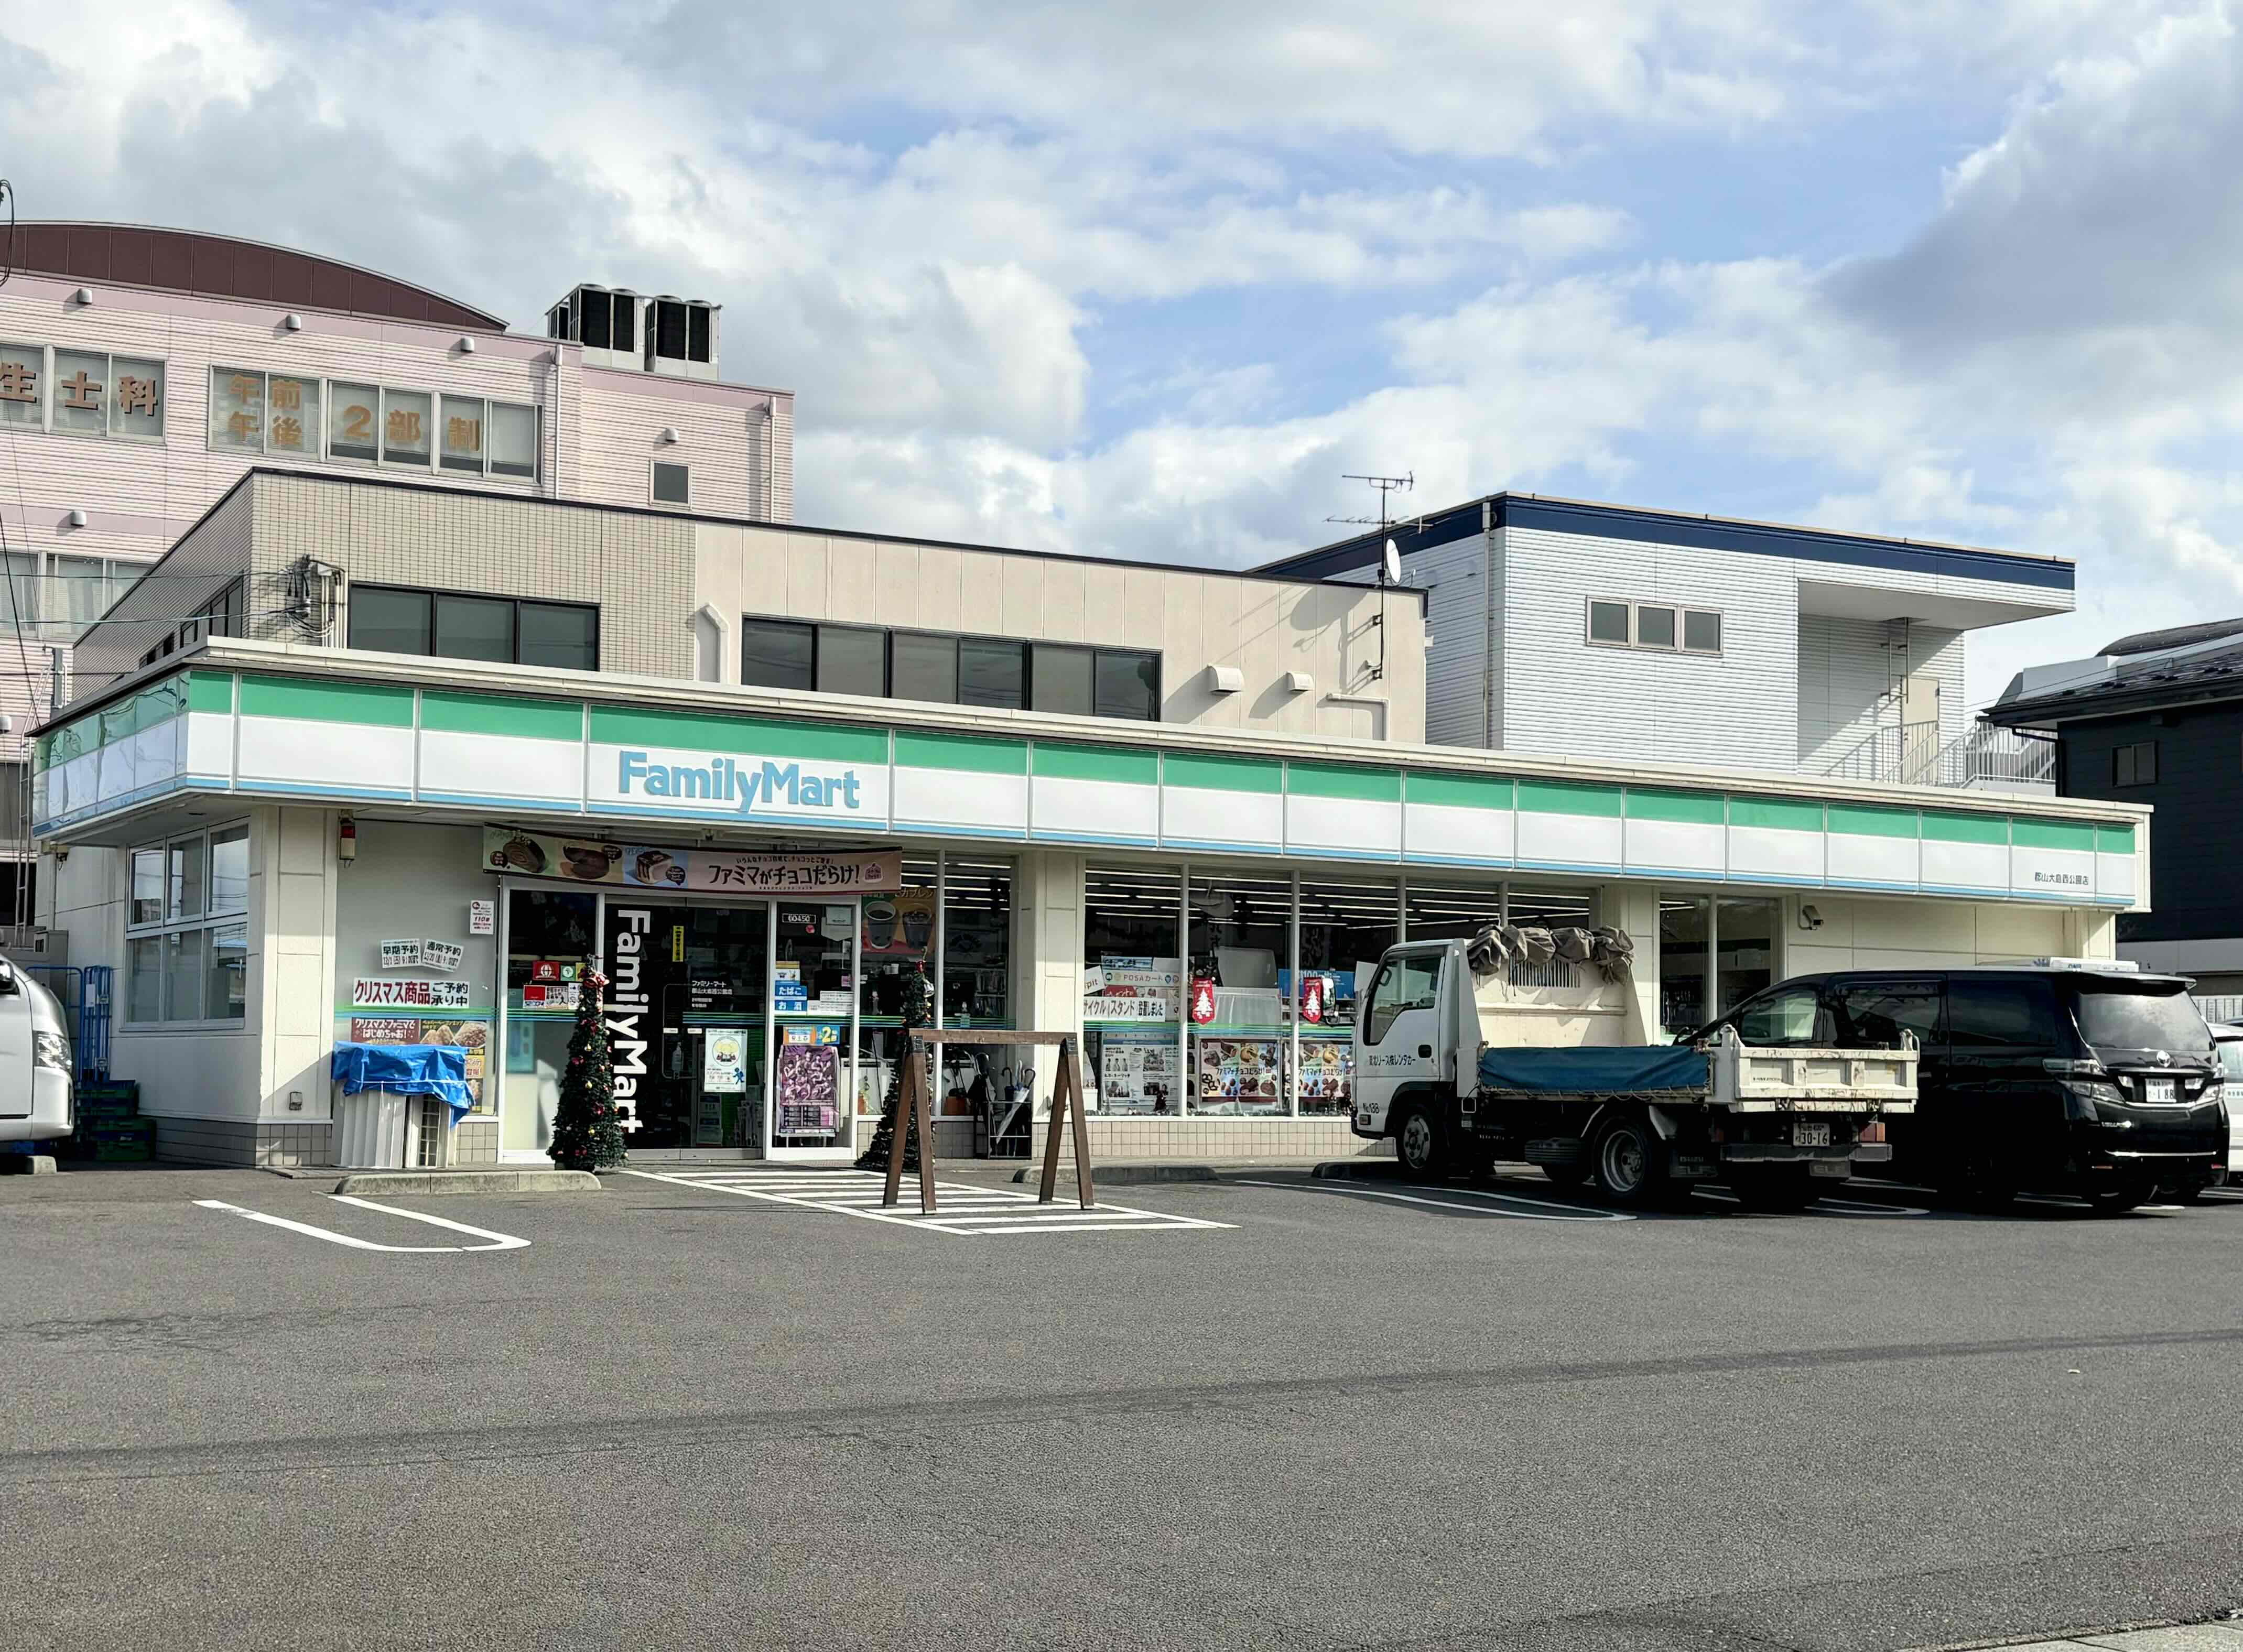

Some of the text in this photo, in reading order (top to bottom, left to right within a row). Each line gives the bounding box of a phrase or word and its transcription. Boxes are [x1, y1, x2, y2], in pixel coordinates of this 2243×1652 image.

[230, 374, 302, 411] 午前
[227, 411, 302, 445] 午後
[343, 405, 480, 452] 2部制
[619, 749, 860, 813] FamilyMart
[709, 865, 860, 885] ファミマがチョコだらけ!
[383, 944, 419, 955] 早期予約
[427, 941, 461, 957] 通常予約
[355, 980, 430, 1005] クリスマス商品
[432, 982, 468, 994] ご予約
[778, 986, 801, 995] たばこ
[431, 995, 468, 1006] 承り中
[605, 909, 651, 1134] FamilyMart
